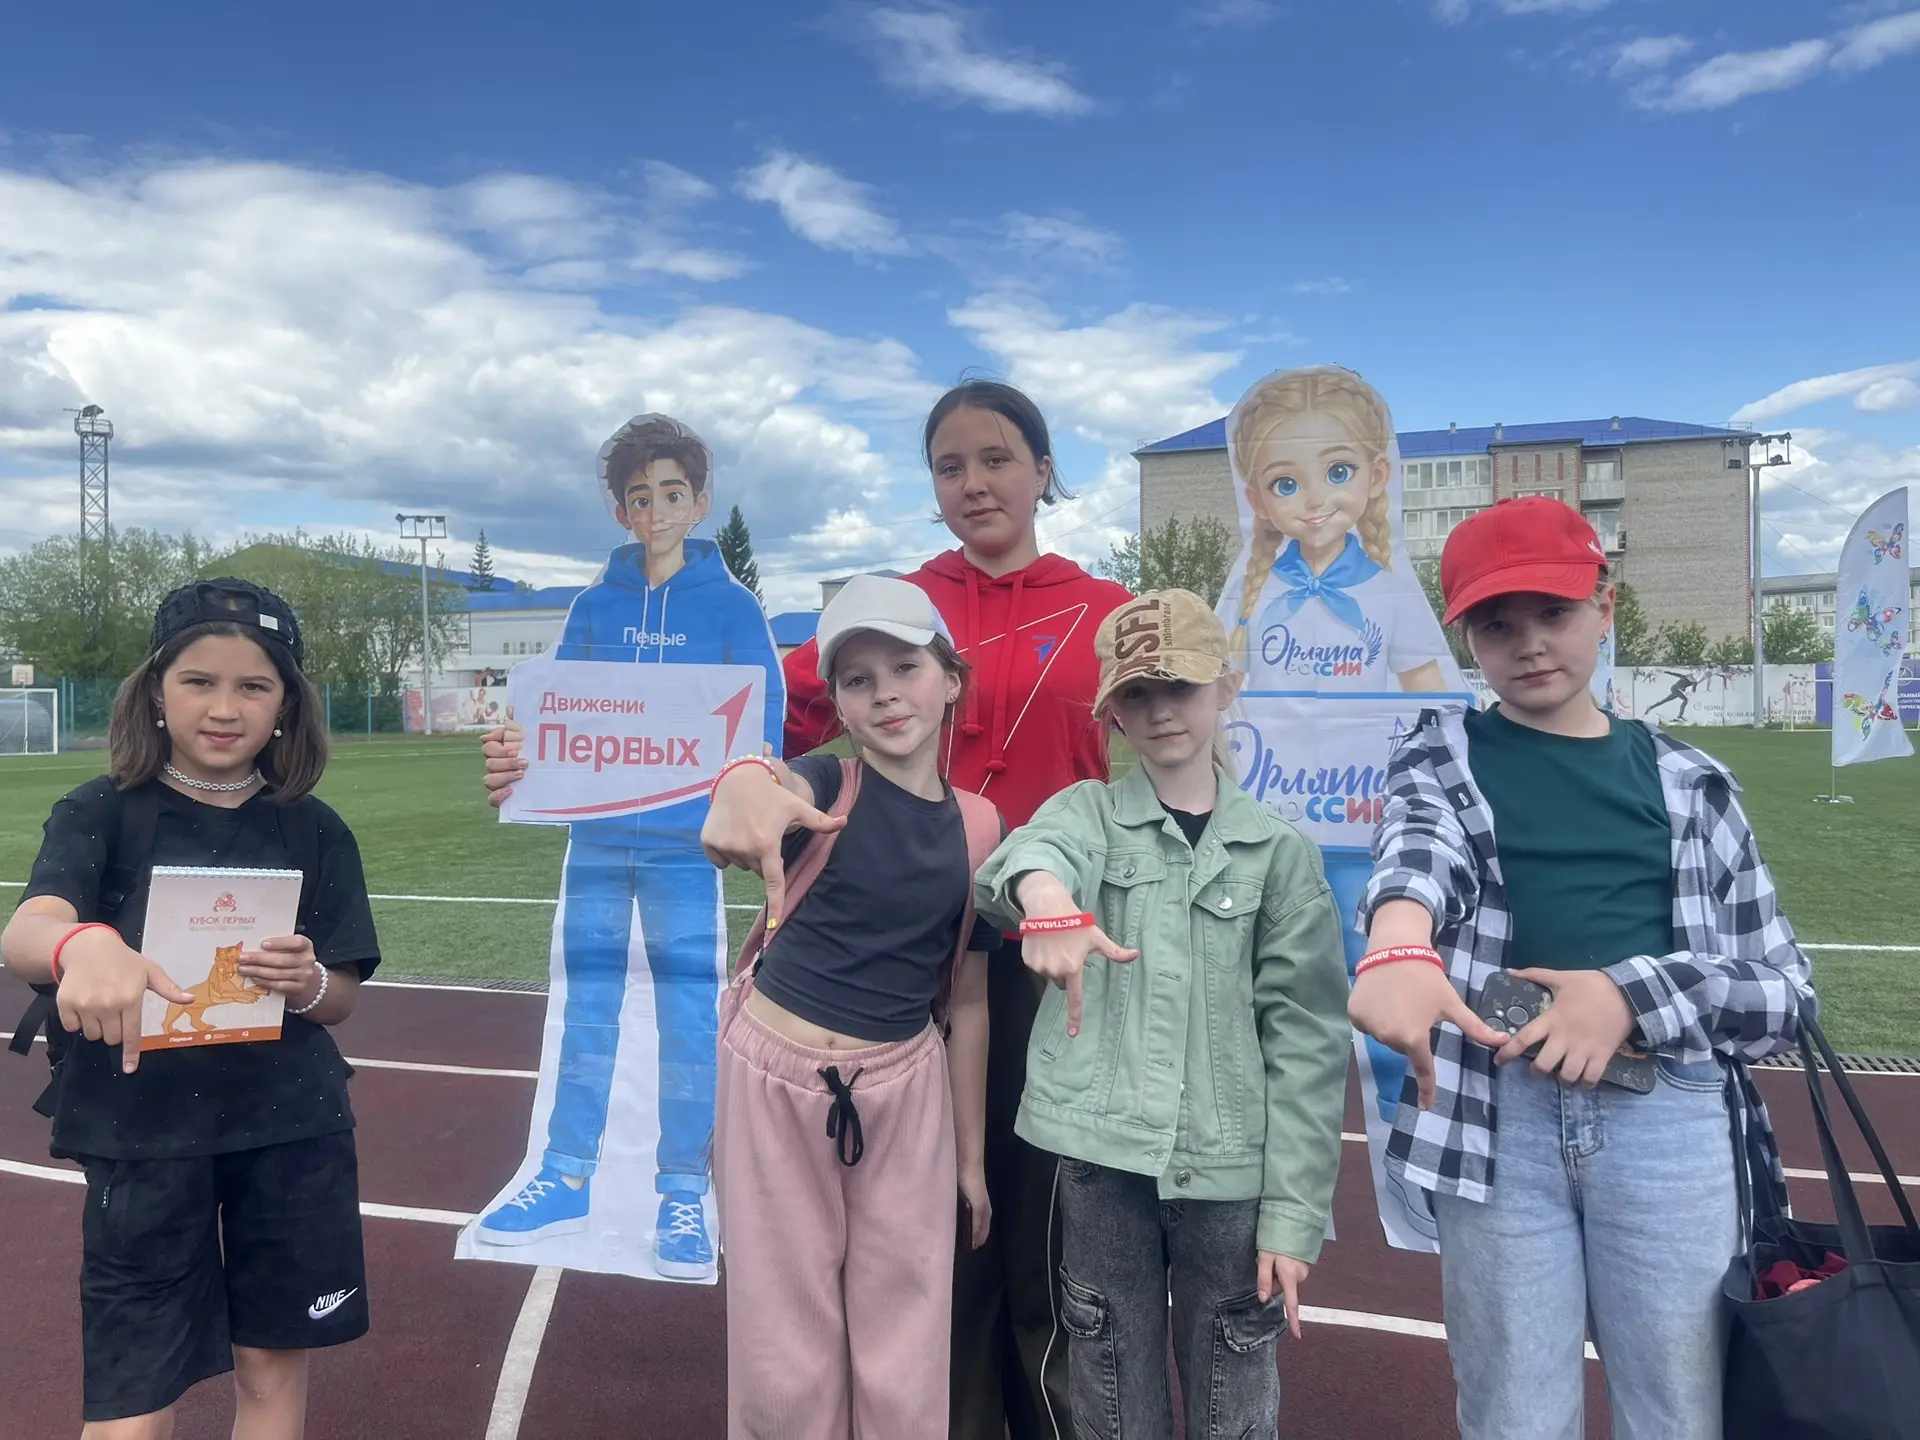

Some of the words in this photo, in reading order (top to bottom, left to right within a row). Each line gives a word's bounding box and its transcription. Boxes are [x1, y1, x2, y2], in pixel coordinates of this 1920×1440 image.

[624, 626, 687, 646] Певые
[1261, 624, 1364, 671] Орлята
[537, 723, 700, 772] Первых
[189, 916, 220, 925] КУБОК
[223, 916, 257, 924] ПЕРВЫХ
[1027, 918, 1082, 930] ФЕСТИВАЛЬ
[1391, 948, 1441, 960] СТИВАЛЬ
[315, 1289, 347, 1310] NIKE
